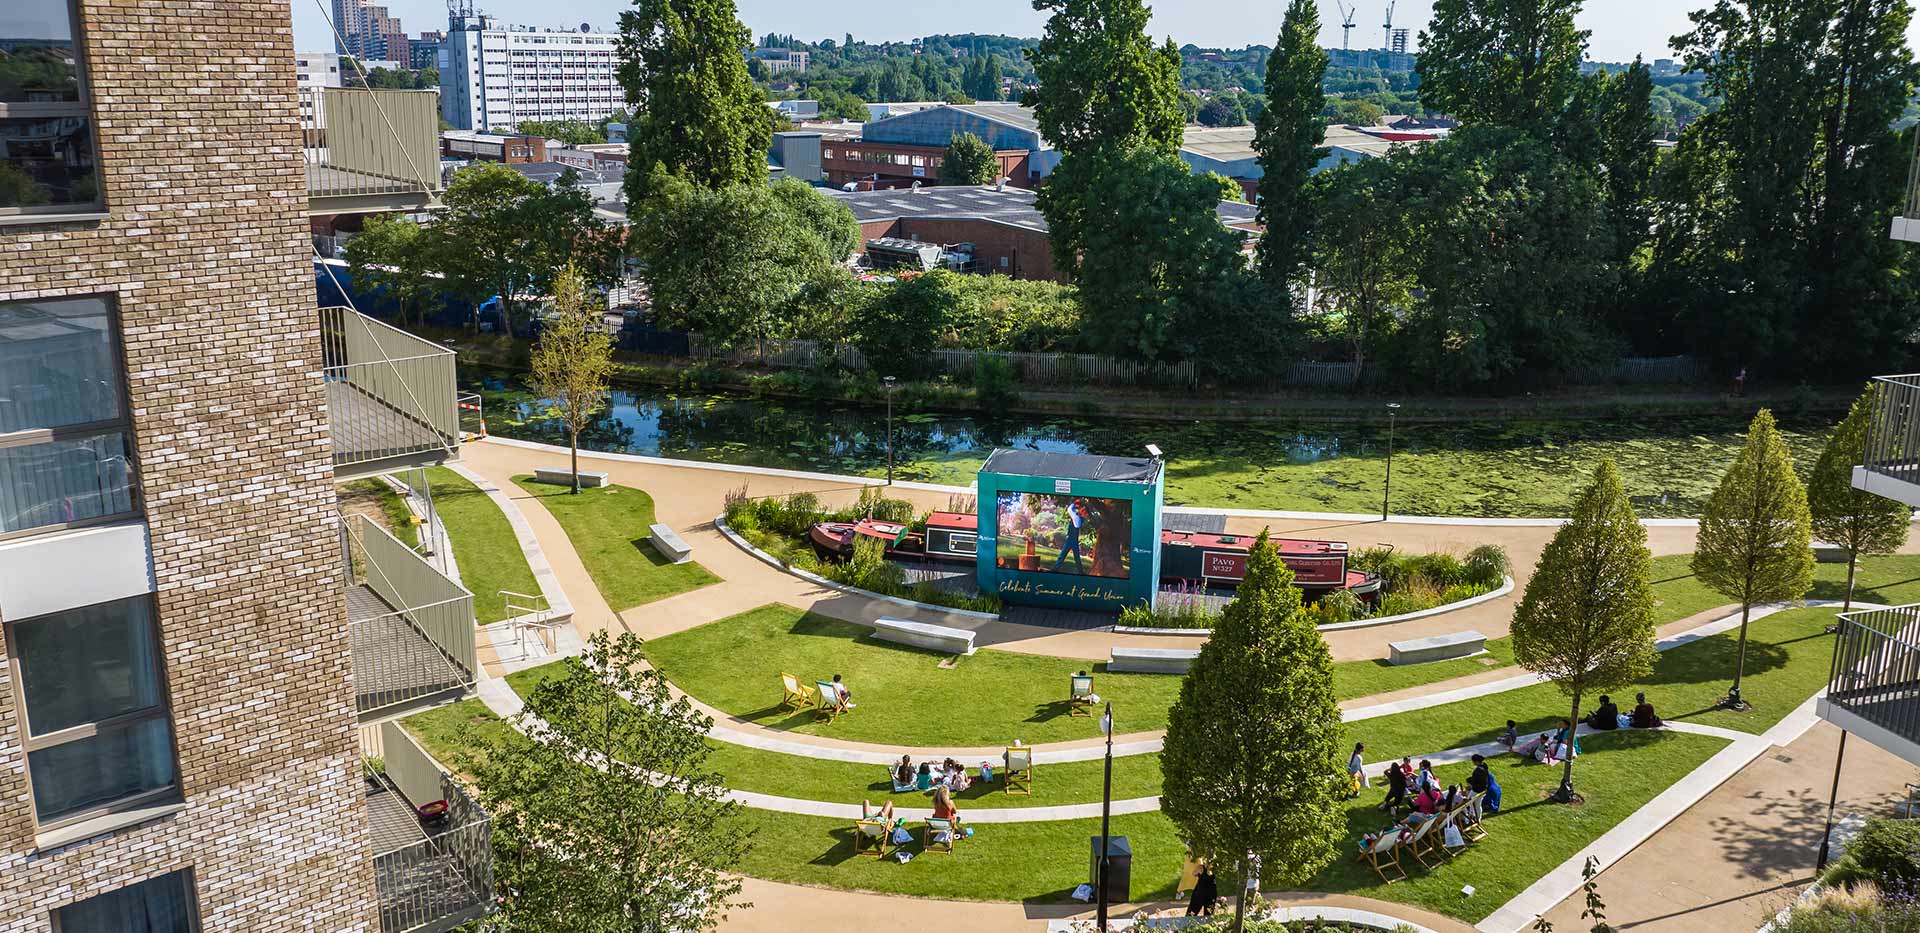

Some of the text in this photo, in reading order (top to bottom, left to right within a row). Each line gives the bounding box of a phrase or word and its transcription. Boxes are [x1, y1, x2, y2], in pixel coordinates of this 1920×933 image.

[999, 580, 1124, 600] Celebrate Summer at Grand Union
